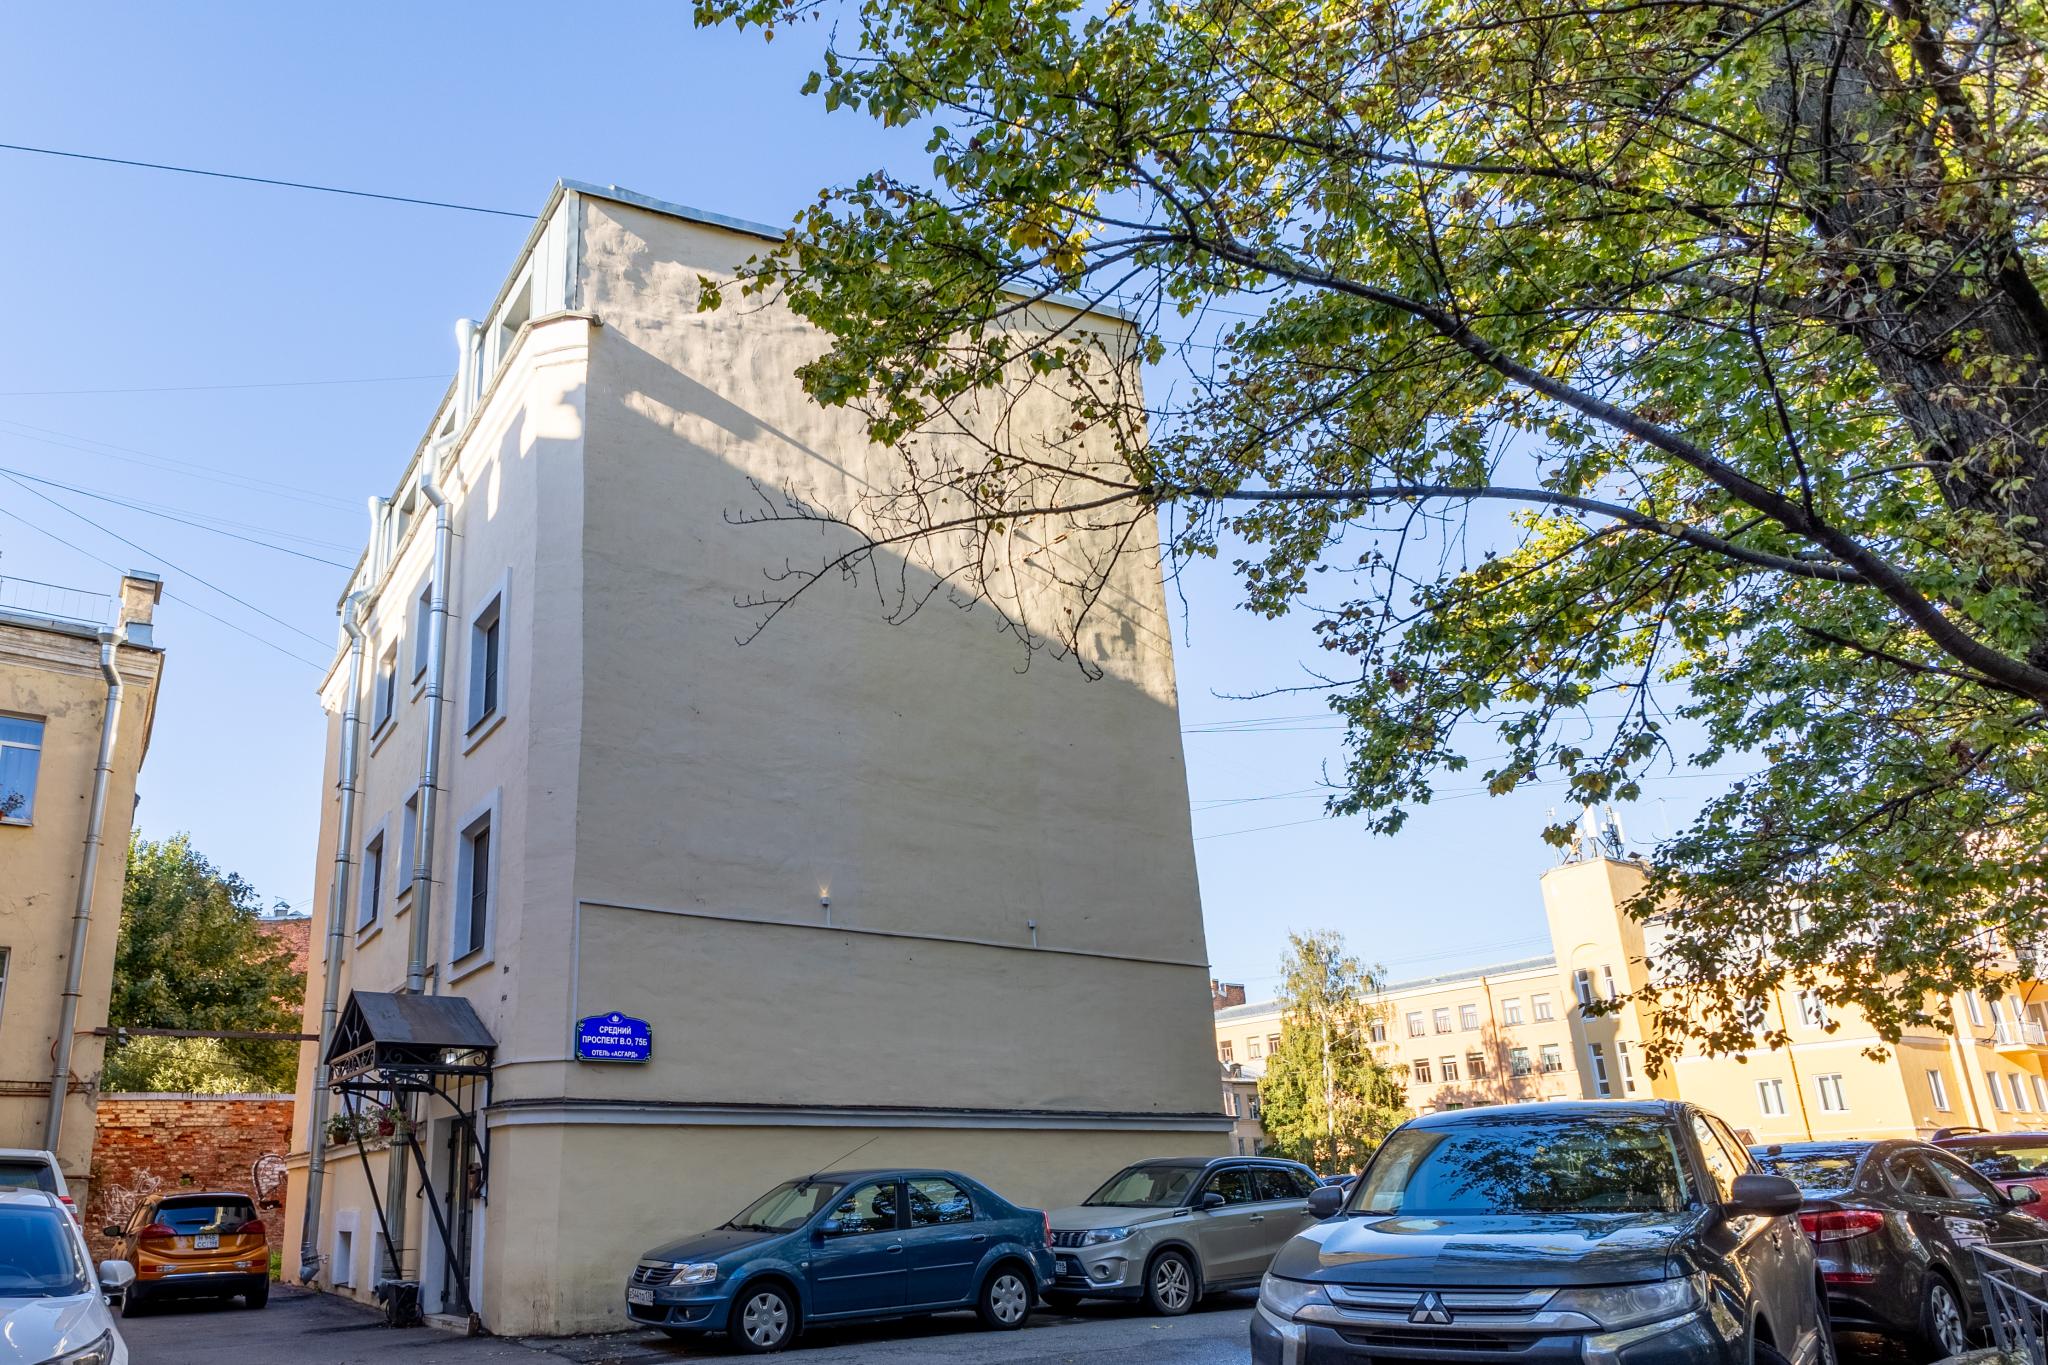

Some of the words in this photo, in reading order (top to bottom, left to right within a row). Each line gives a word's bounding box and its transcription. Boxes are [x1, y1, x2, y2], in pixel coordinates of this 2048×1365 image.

[599, 1026, 632, 1035] СРЕДНИЙ
[582, 1035, 618, 1045] ПРОСПЕКТ
[591, 1049, 610, 1057] ОТЕЛЬ
